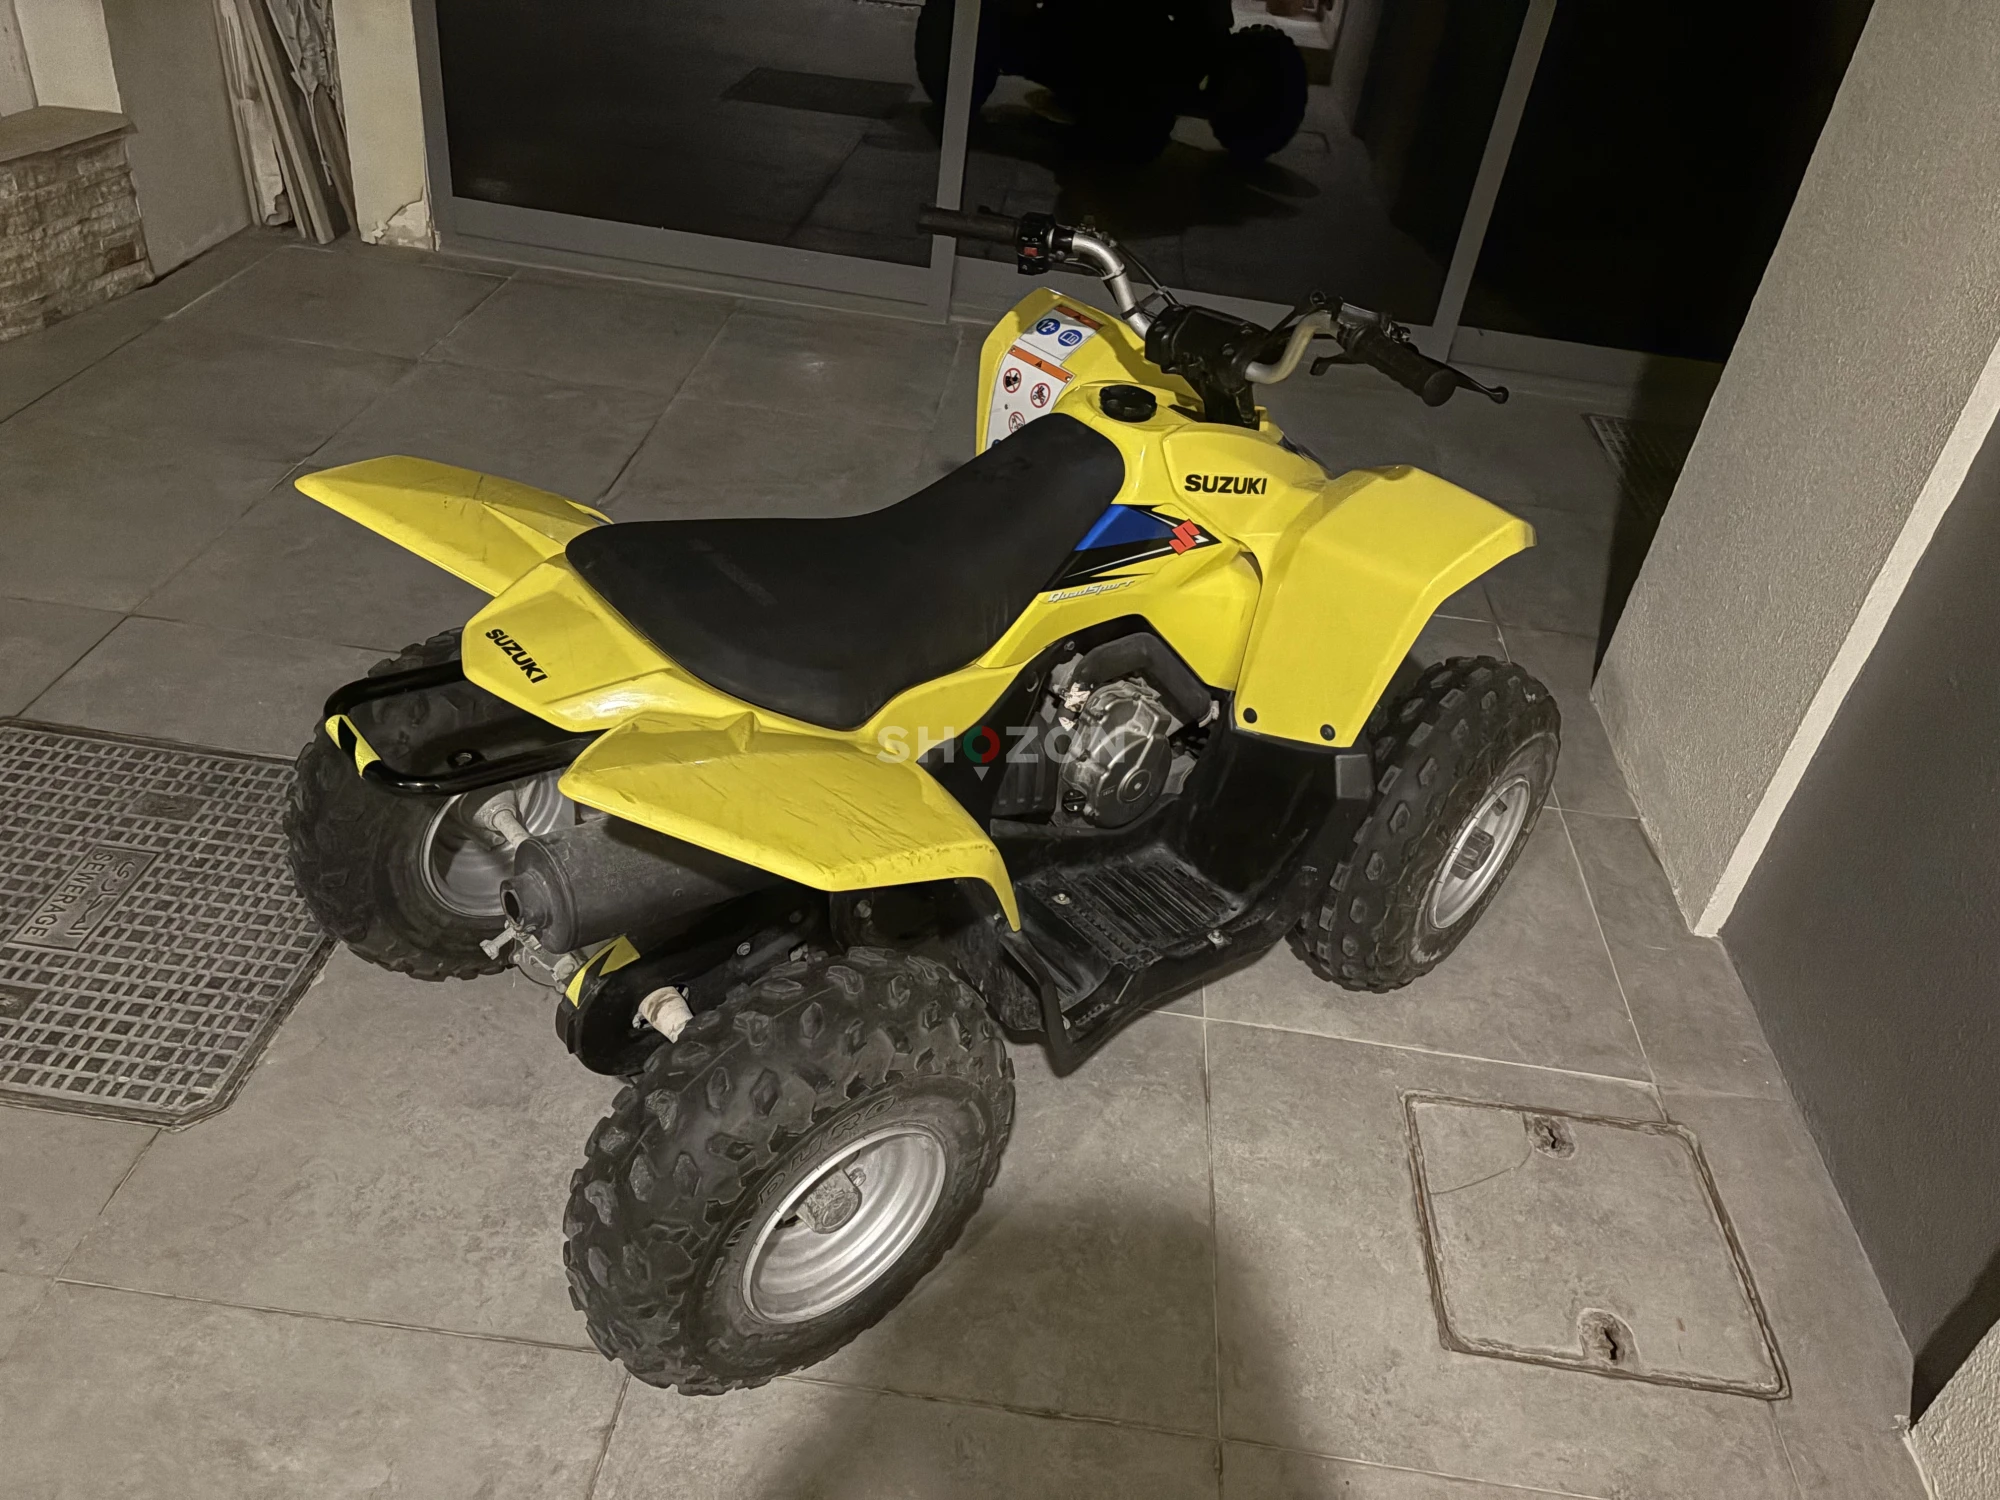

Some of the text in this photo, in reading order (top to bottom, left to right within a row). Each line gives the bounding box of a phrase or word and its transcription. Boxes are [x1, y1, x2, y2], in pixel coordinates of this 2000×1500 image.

[1037, 318, 1056, 334] 12+
[1184, 473, 1268, 495] SUZUKI
[484, 628, 549, 684] SUZUKI
[23, 851, 114, 938] SEWERAGE
[65, 861, 136, 936] المجاري
